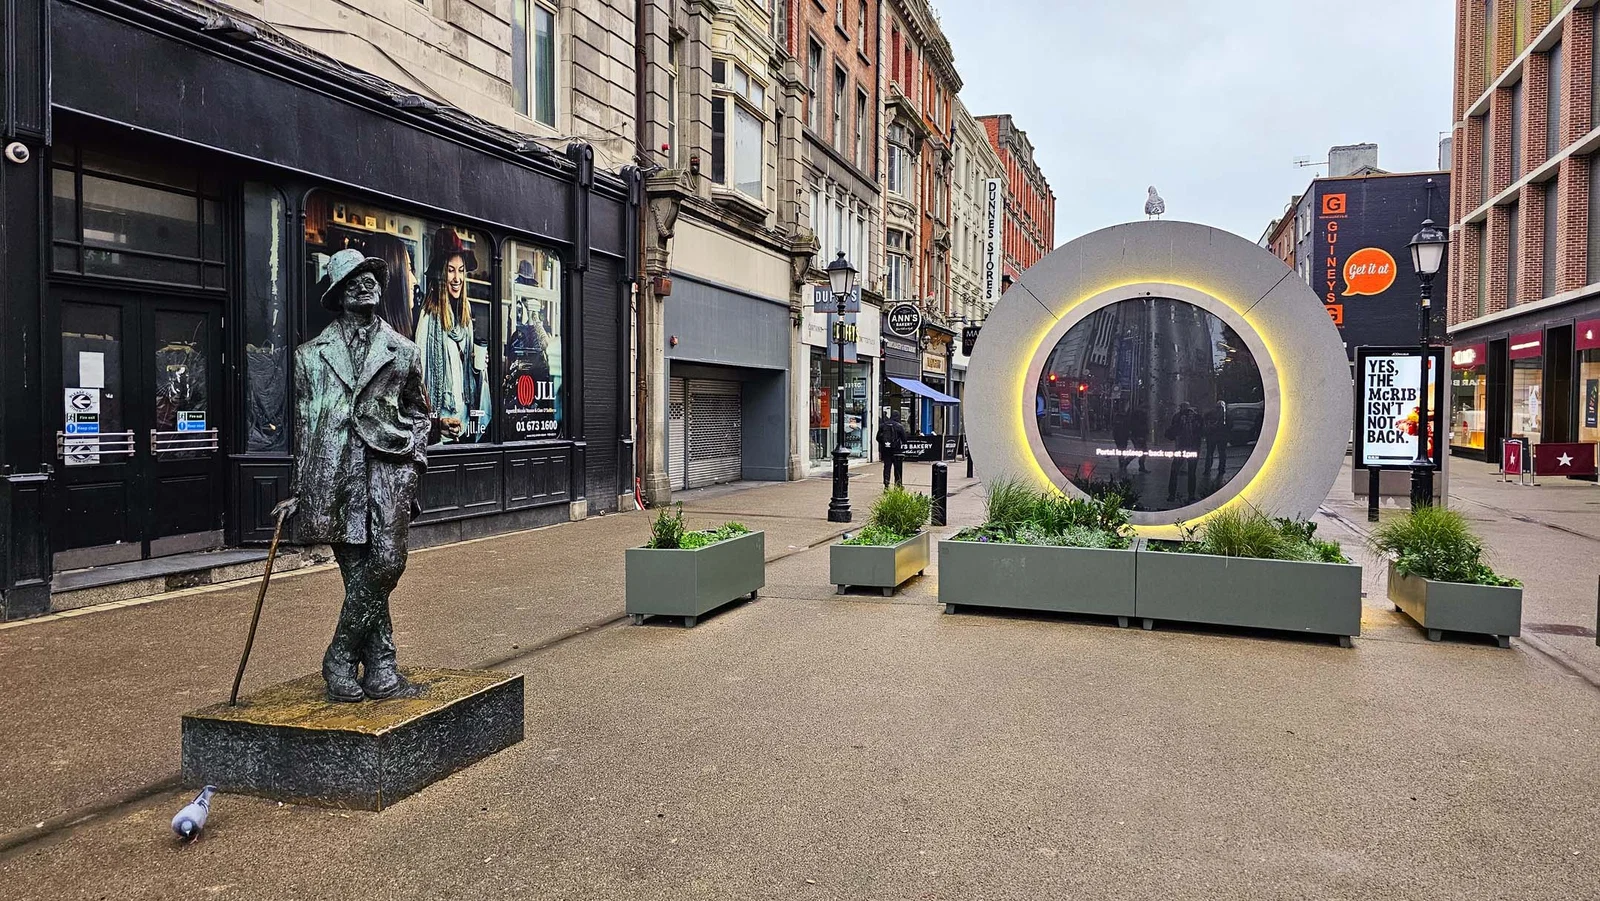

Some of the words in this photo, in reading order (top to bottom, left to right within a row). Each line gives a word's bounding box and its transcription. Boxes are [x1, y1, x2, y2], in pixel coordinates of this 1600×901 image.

[988, 182, 997, 239] DUNNES
[1326, 196, 1341, 211] G
[1326, 221, 1338, 302] GUINEYS
[986, 242, 996, 299] STORES
[1348, 264, 1366, 280] Get
[1368, 263, 1376, 274] it
[1377, 263, 1389, 274] at
[815, 290, 857, 302] DUFS
[891, 314, 918, 322] ANN'S
[1368, 359, 1399, 376] YES,
[1368, 374, 1394, 387] THE
[534, 381, 557, 400] JLL
[1368, 388, 1417, 401] McRIB
[1368, 402, 1404, 415] ISN'T
[466, 421, 485, 437] jll.ie
[516, 421, 526, 432] 01
[526, 420, 540, 431] 673
[541, 420, 558, 430] 1600
[1367, 416, 1396, 429] NOT
[1367, 430, 1409, 444] BACK.
[1122, 449, 1143, 457] asleep
[1182, 450, 1197, 458] 1pm
